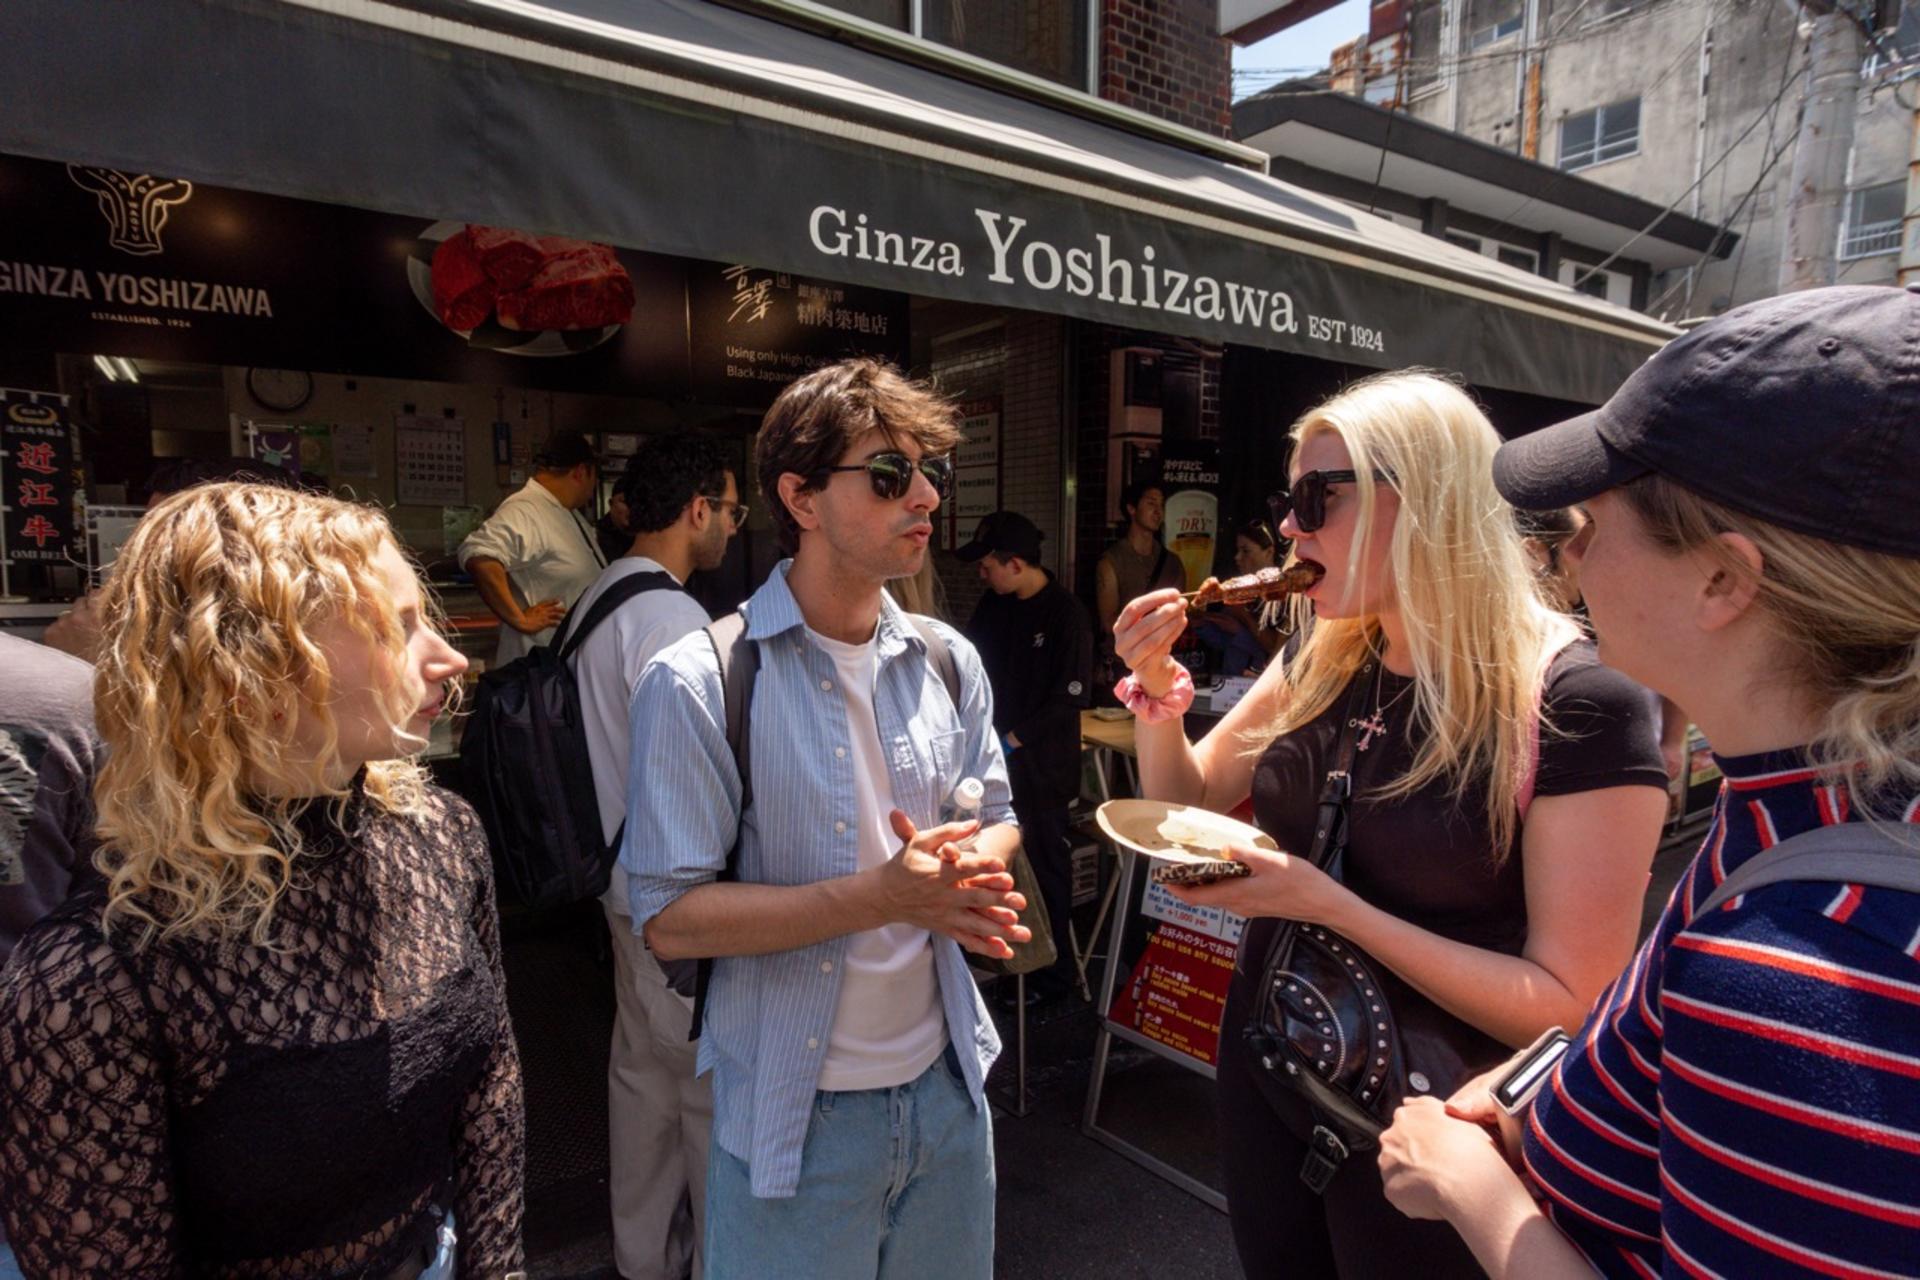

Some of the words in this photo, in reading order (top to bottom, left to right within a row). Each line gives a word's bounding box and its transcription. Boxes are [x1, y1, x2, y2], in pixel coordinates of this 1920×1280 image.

[0, 260, 93, 300] GINZA
[96, 271, 273, 318] YOSHIZAWA
[808, 204, 965, 277] Ginza
[974, 208, 1298, 334] Yoshizawa
[1308, 314, 1346, 344] EST
[726, 345, 756, 362] Using
[757, 350, 778, 366] only
[781, 352, 802, 367] High
[727, 364, 755, 378] Black
[16, 442, 59, 547] 近江牛
